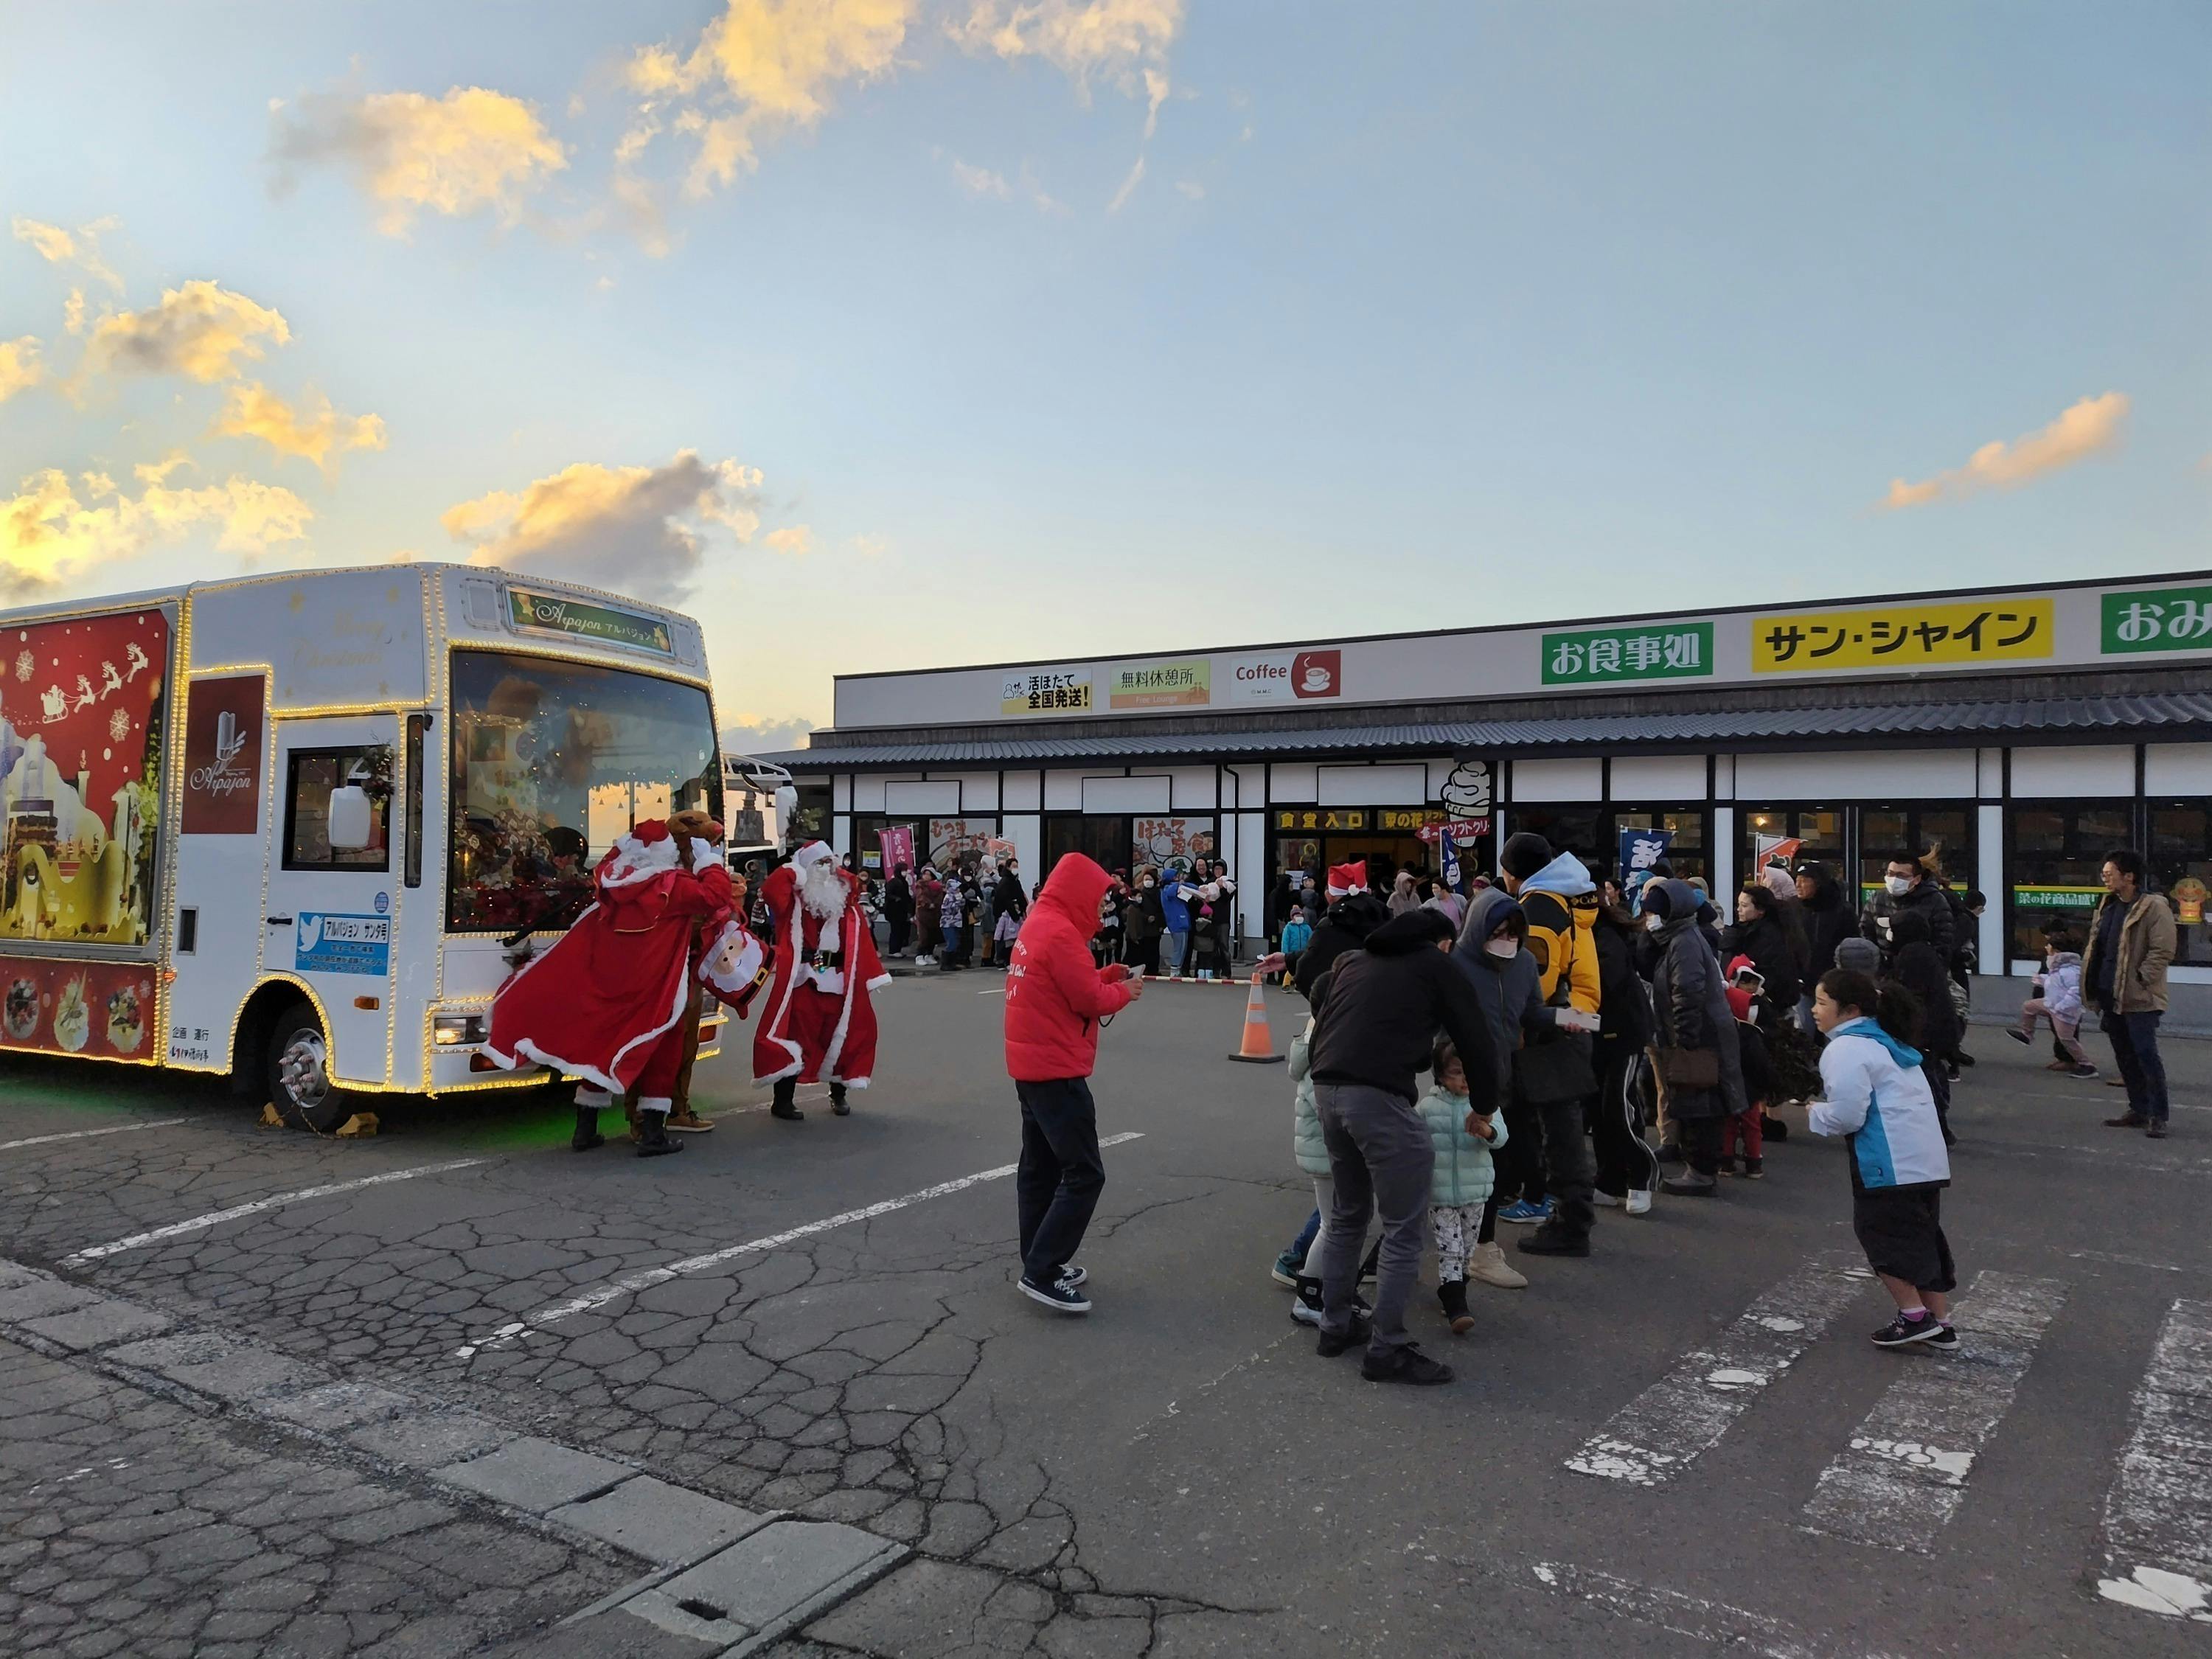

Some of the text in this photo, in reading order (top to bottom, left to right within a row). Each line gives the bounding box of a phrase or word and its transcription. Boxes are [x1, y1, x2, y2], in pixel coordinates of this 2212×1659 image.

[535, 603, 602, 632] Arpajon
[1765, 612, 2037, 662] サン・シャイン
[1551, 632, 1701, 675] お食事処
[1029, 674, 1075, 690] 活ほたて
[1121, 667, 1194, 689] 無料休憩所
[1236, 664, 1287, 681] Coffee
[190, 760, 251, 797] Arpajon
[1138, 819, 1186, 841] ほたて
[1280, 813, 1363, 828] 食堂入口
[1385, 812, 1423, 828] 菜の花
